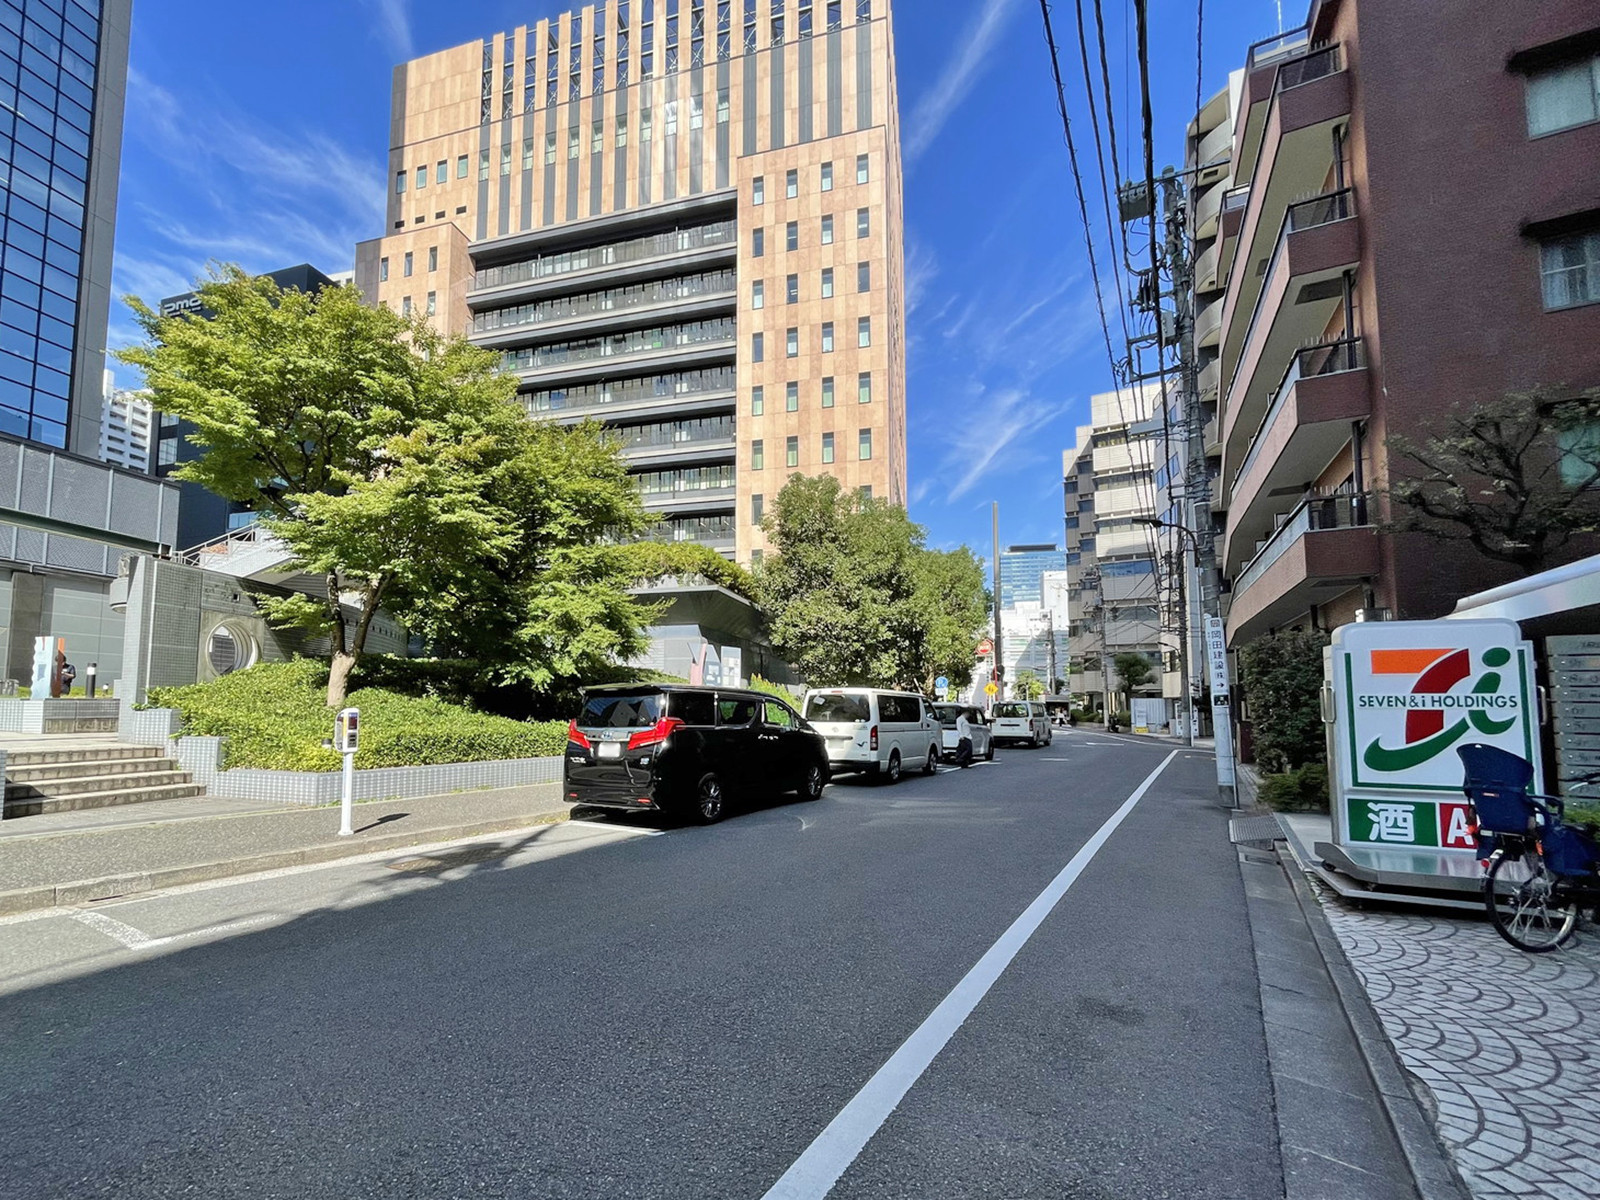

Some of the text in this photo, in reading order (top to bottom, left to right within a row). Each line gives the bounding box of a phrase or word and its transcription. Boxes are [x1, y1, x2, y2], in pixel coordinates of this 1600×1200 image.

[164, 297, 202, 315] pmo
[1430, 695, 1518, 708] HOLDINGS
[1366, 801, 1415, 842] 酒
